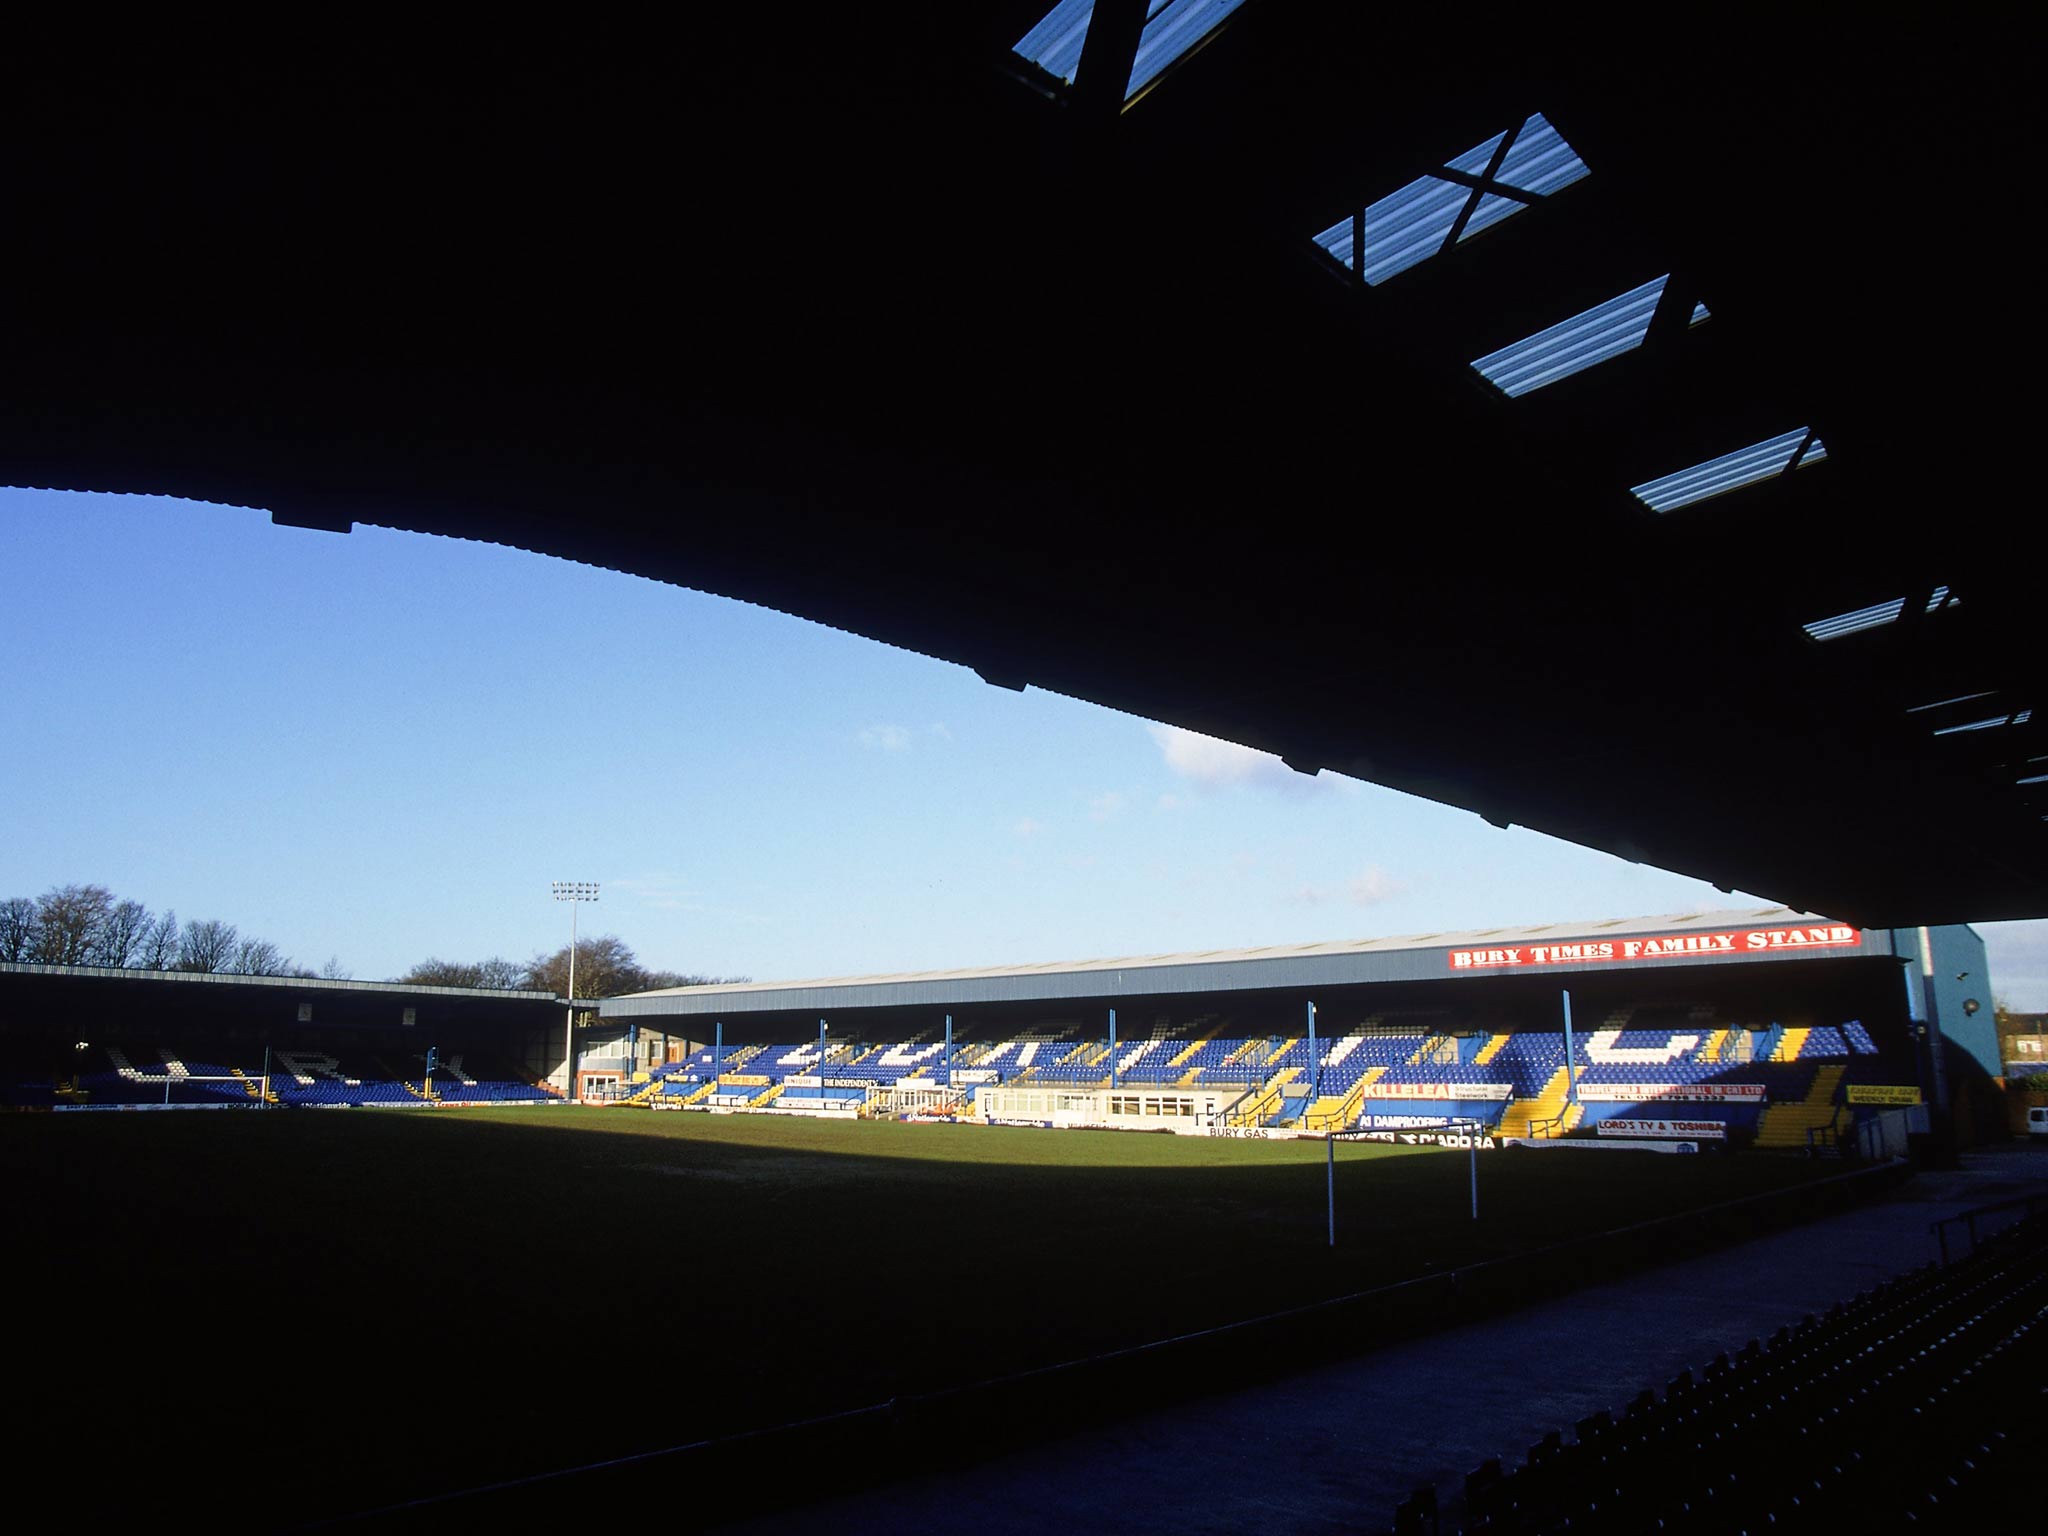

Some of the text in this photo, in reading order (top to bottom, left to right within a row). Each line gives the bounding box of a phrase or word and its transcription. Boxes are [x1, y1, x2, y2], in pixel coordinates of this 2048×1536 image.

[1453, 926, 1854, 967] BURY TIMES FAMILY STAND
[1363, 1084, 1449, 1099] KILLELEA
[1642, 1086, 1707, 1094] INTERNATIONAL
[1374, 1116, 1448, 1128] DAMPROOFING
[1598, 1121, 1723, 1131] LORD'S TV & TOSHIBA
[1209, 1128, 1241, 1137] BURY
[1244, 1129, 1269, 1138] GAS
